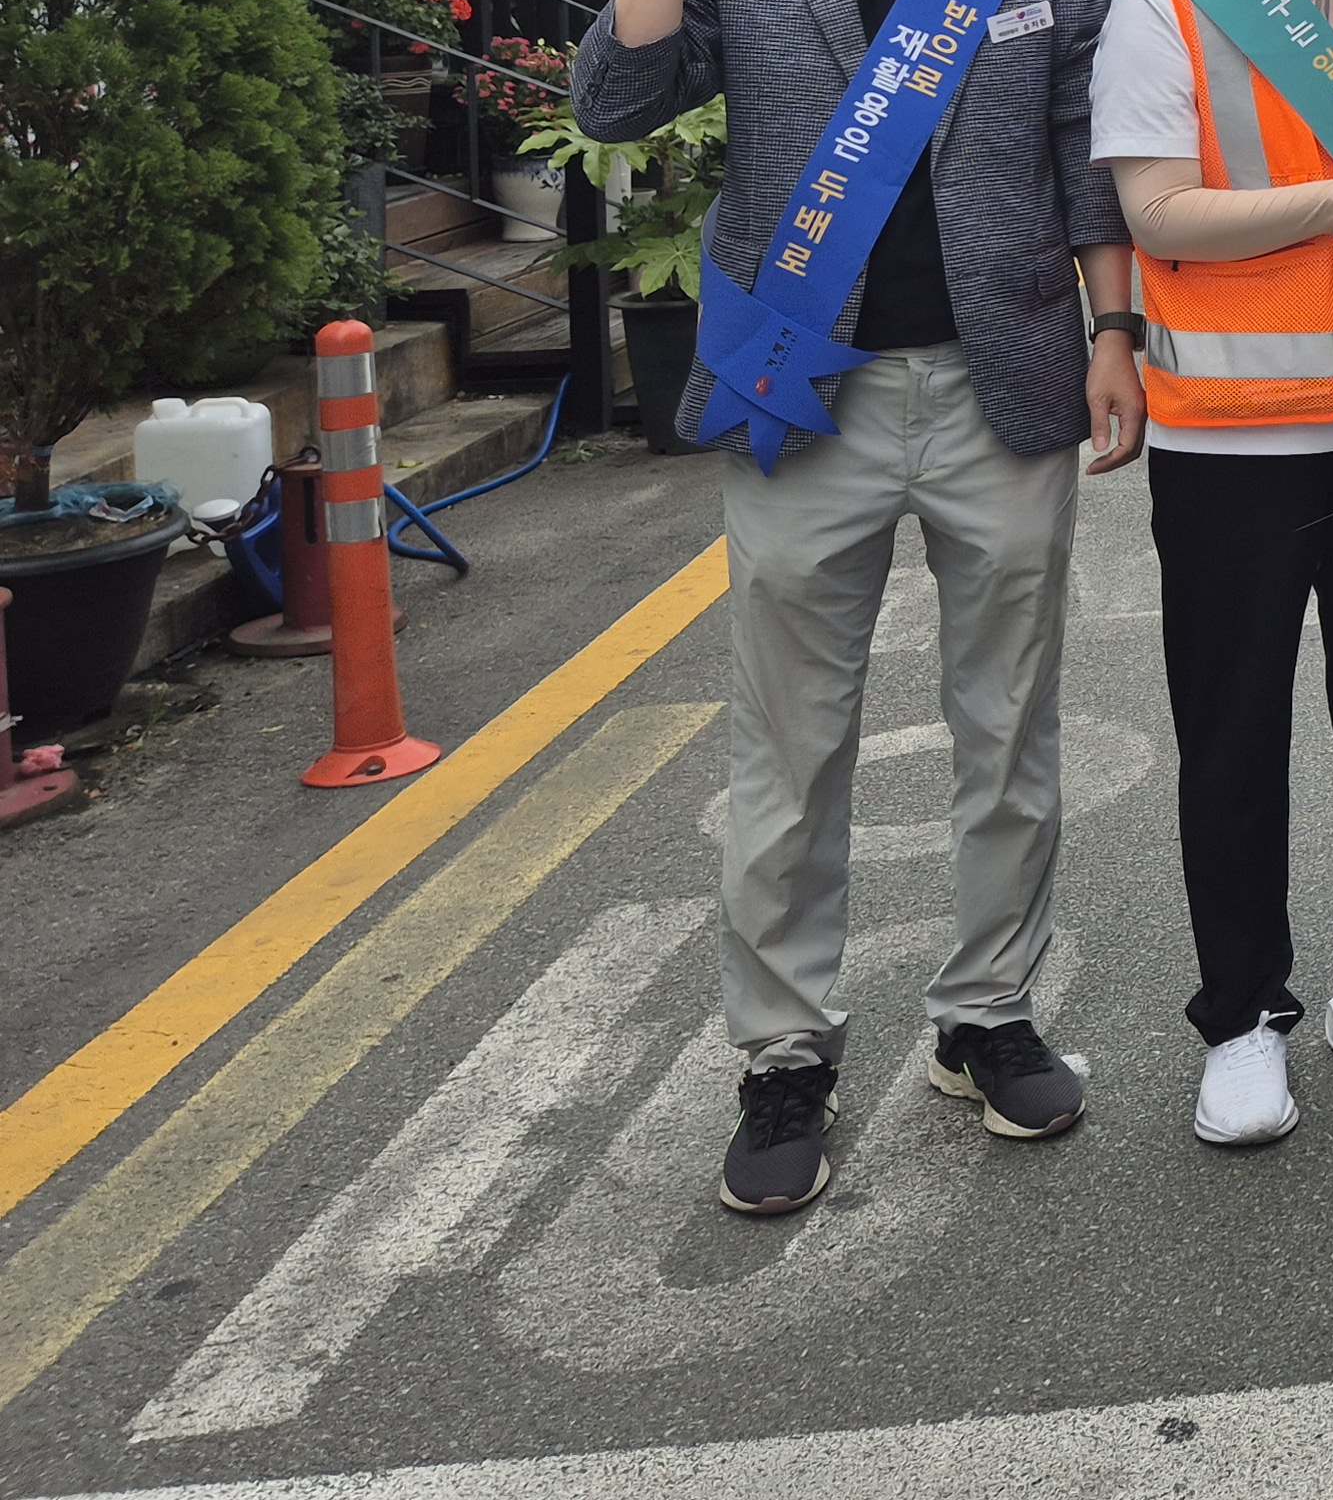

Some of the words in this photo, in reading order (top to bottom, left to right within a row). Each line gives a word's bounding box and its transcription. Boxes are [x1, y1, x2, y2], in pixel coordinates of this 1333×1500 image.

[833, 24, 926, 163] 재활용은
[904, 0, 979, 98] 반으로
[776, 169, 846, 278] 두배로
